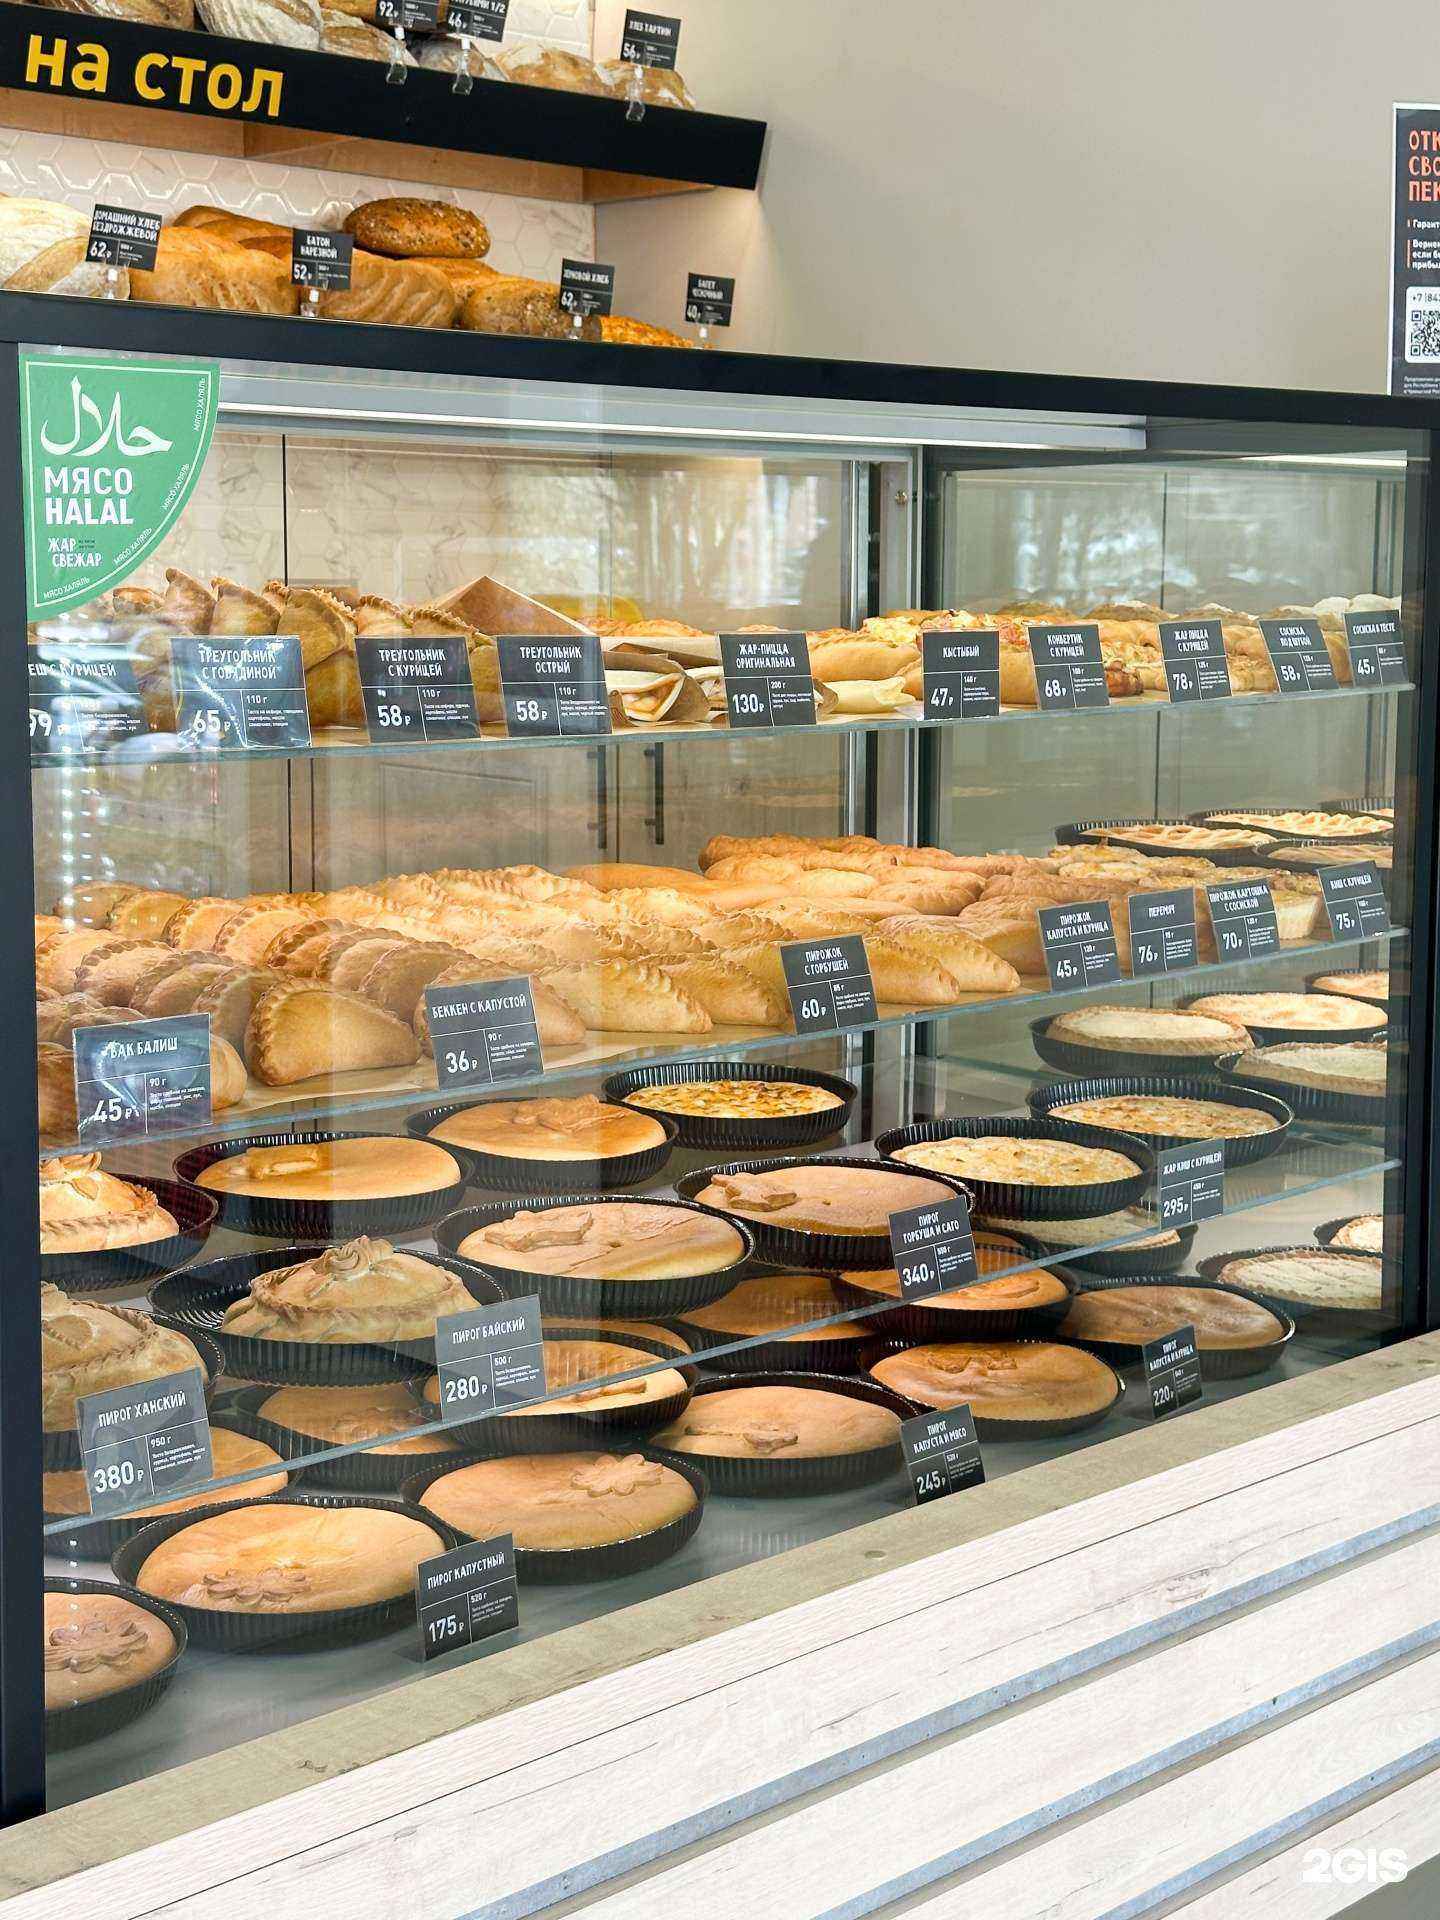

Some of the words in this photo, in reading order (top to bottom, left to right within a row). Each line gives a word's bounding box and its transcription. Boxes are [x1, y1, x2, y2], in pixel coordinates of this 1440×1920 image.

[135, 53, 284, 117] стол
[94, 210, 137, 226] ДОМАШНИЙ
[138, 216, 161, 231] ХЛЕБ
[92, 221, 157, 241] БЕЗДРОЖЖЕВОЙ
[306, 235, 331, 247] БАТОН
[300, 245, 338, 259] НАРЕЗНОЙ
[1412, 250, 1432, 259] если
[44, 466, 133, 495] МЯСО
[45, 498, 134, 525] HALAL
[48, 537, 76, 552] ЖАР
[52, 552, 102, 568] СВЕЖАР
[1352, 624, 1376, 635] СОСИСКА
[1047, 633, 1084, 645] КОНВЕРТИК
[1183, 640, 1208, 652] КУРИЦЕЙ
[199, 649, 276, 663] ТРЕУГОЛЬНИК
[378, 649, 447, 662] ТРЕУГОЛЬНИК
[520, 646, 582, 659] ТРЕУГОЛЬНИК
[739, 643, 789, 656] ЖАР-ПИЦЦА
[943, 645, 980, 659] КЫСТЫБЫЙ
[1055, 645, 1085, 658] КУРИЦЕЙ
[388, 665, 395, 677] С
[396, 663, 443, 677] КУРИЦЕЙ
[535, 660, 571, 673] ОСТРЫЙ
[736, 656, 796, 669] ОРИГИНАЛЬНАЯ
[202, 667, 210, 679] С
[211, 665, 277, 680] ГОВЯДИНОЙ
[422, 689, 435, 698] 110
[559, 687, 572, 696] 110
[1347, 873, 1372, 888] КУРИЦЕЙ
[1209, 890, 1237, 903] ПИРОЖОК
[1237, 885, 1269, 899] КАРТОШКА
[1229, 898, 1259, 912] СОСИСКОЙ
[1060, 911, 1092, 926] ПИРОЖОК
[1046, 925, 1077, 940] КАПУСТА
[1083, 921, 1109, 936] КУРИЦА
[805, 946, 843, 963] ПИРОЖОК
[804, 965, 810, 976] С
[810, 958, 849, 975] ГОРБУШЕЙ
[431, 1002, 469, 1019] БЕККЕН
[470, 1002, 477, 1013] С
[478, 993, 527, 1013] КАПУСТОЙ
[137, 1037, 178, 1057] БАЛИШ
[149, 1078, 160, 1087] 90
[1163, 1163, 1176, 1175] ЖАР
[1195, 1151, 1222, 1167] КУРИЦЕЙ
[918, 1211, 939, 1227] ПИРОГ
[903, 1227, 935, 1244] ГОРБУША
[941, 1219, 960, 1234] САГО
[452, 1327, 480, 1344] ПИРОГ
[482, 1315, 526, 1338] БАЙСКИЙ
[1149, 1355, 1171, 1372] КАПУСТА
[98, 1406, 132, 1427] ПИРОГ
[134, 1390, 187, 1418] ХАНСКИЙ
[927, 1420, 947, 1436] ПИРОГ
[150, 1437, 166, 1448] 950
[913, 1435, 944, 1454] КАПУСТА
[949, 1427, 967, 1441] МЯСО
[427, 1570, 453, 1590] ПИРОГ
[454, 1551, 505, 1580] КАПУСТНЫЙ
